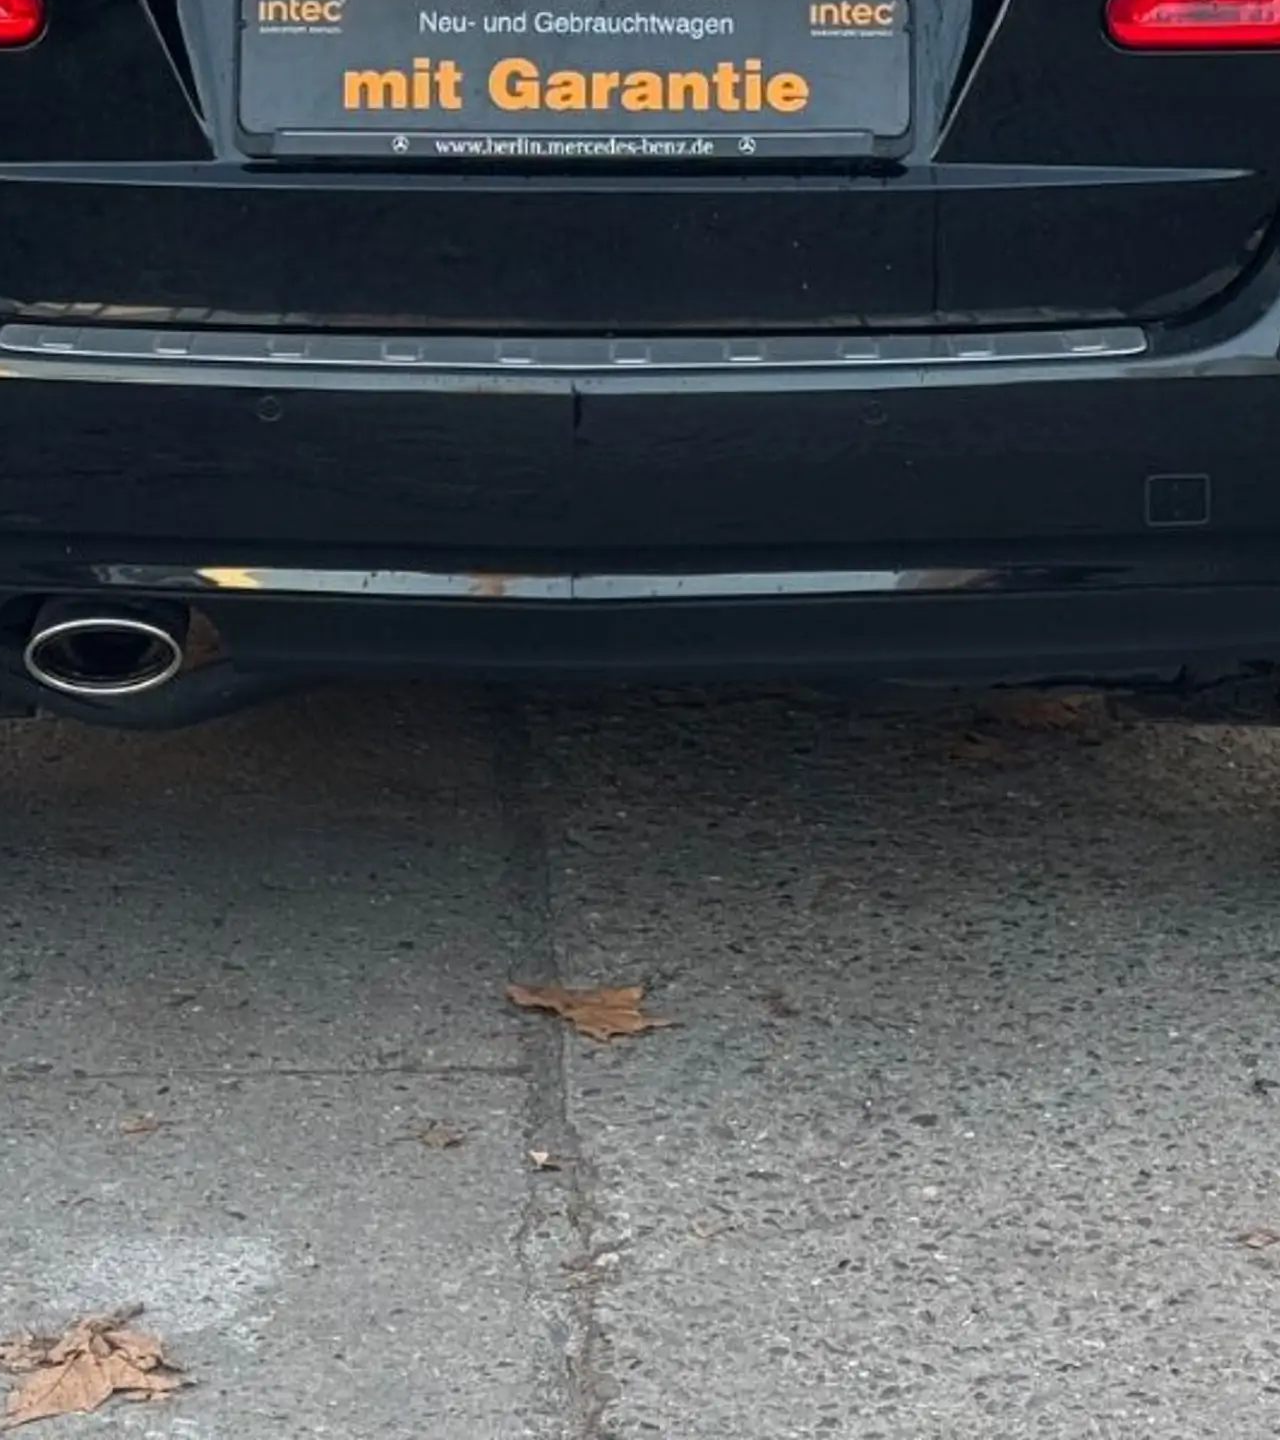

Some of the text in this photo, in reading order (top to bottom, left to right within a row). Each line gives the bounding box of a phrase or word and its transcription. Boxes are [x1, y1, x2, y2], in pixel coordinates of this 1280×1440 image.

[419, 12, 735, 40] Neu- und Gebrauchtwagen
[810, 0, 895, 26] intec
[343, 57, 811, 112] mit Garantie
[434, 137, 714, 157] www.berlin.mercedes-benz.de
